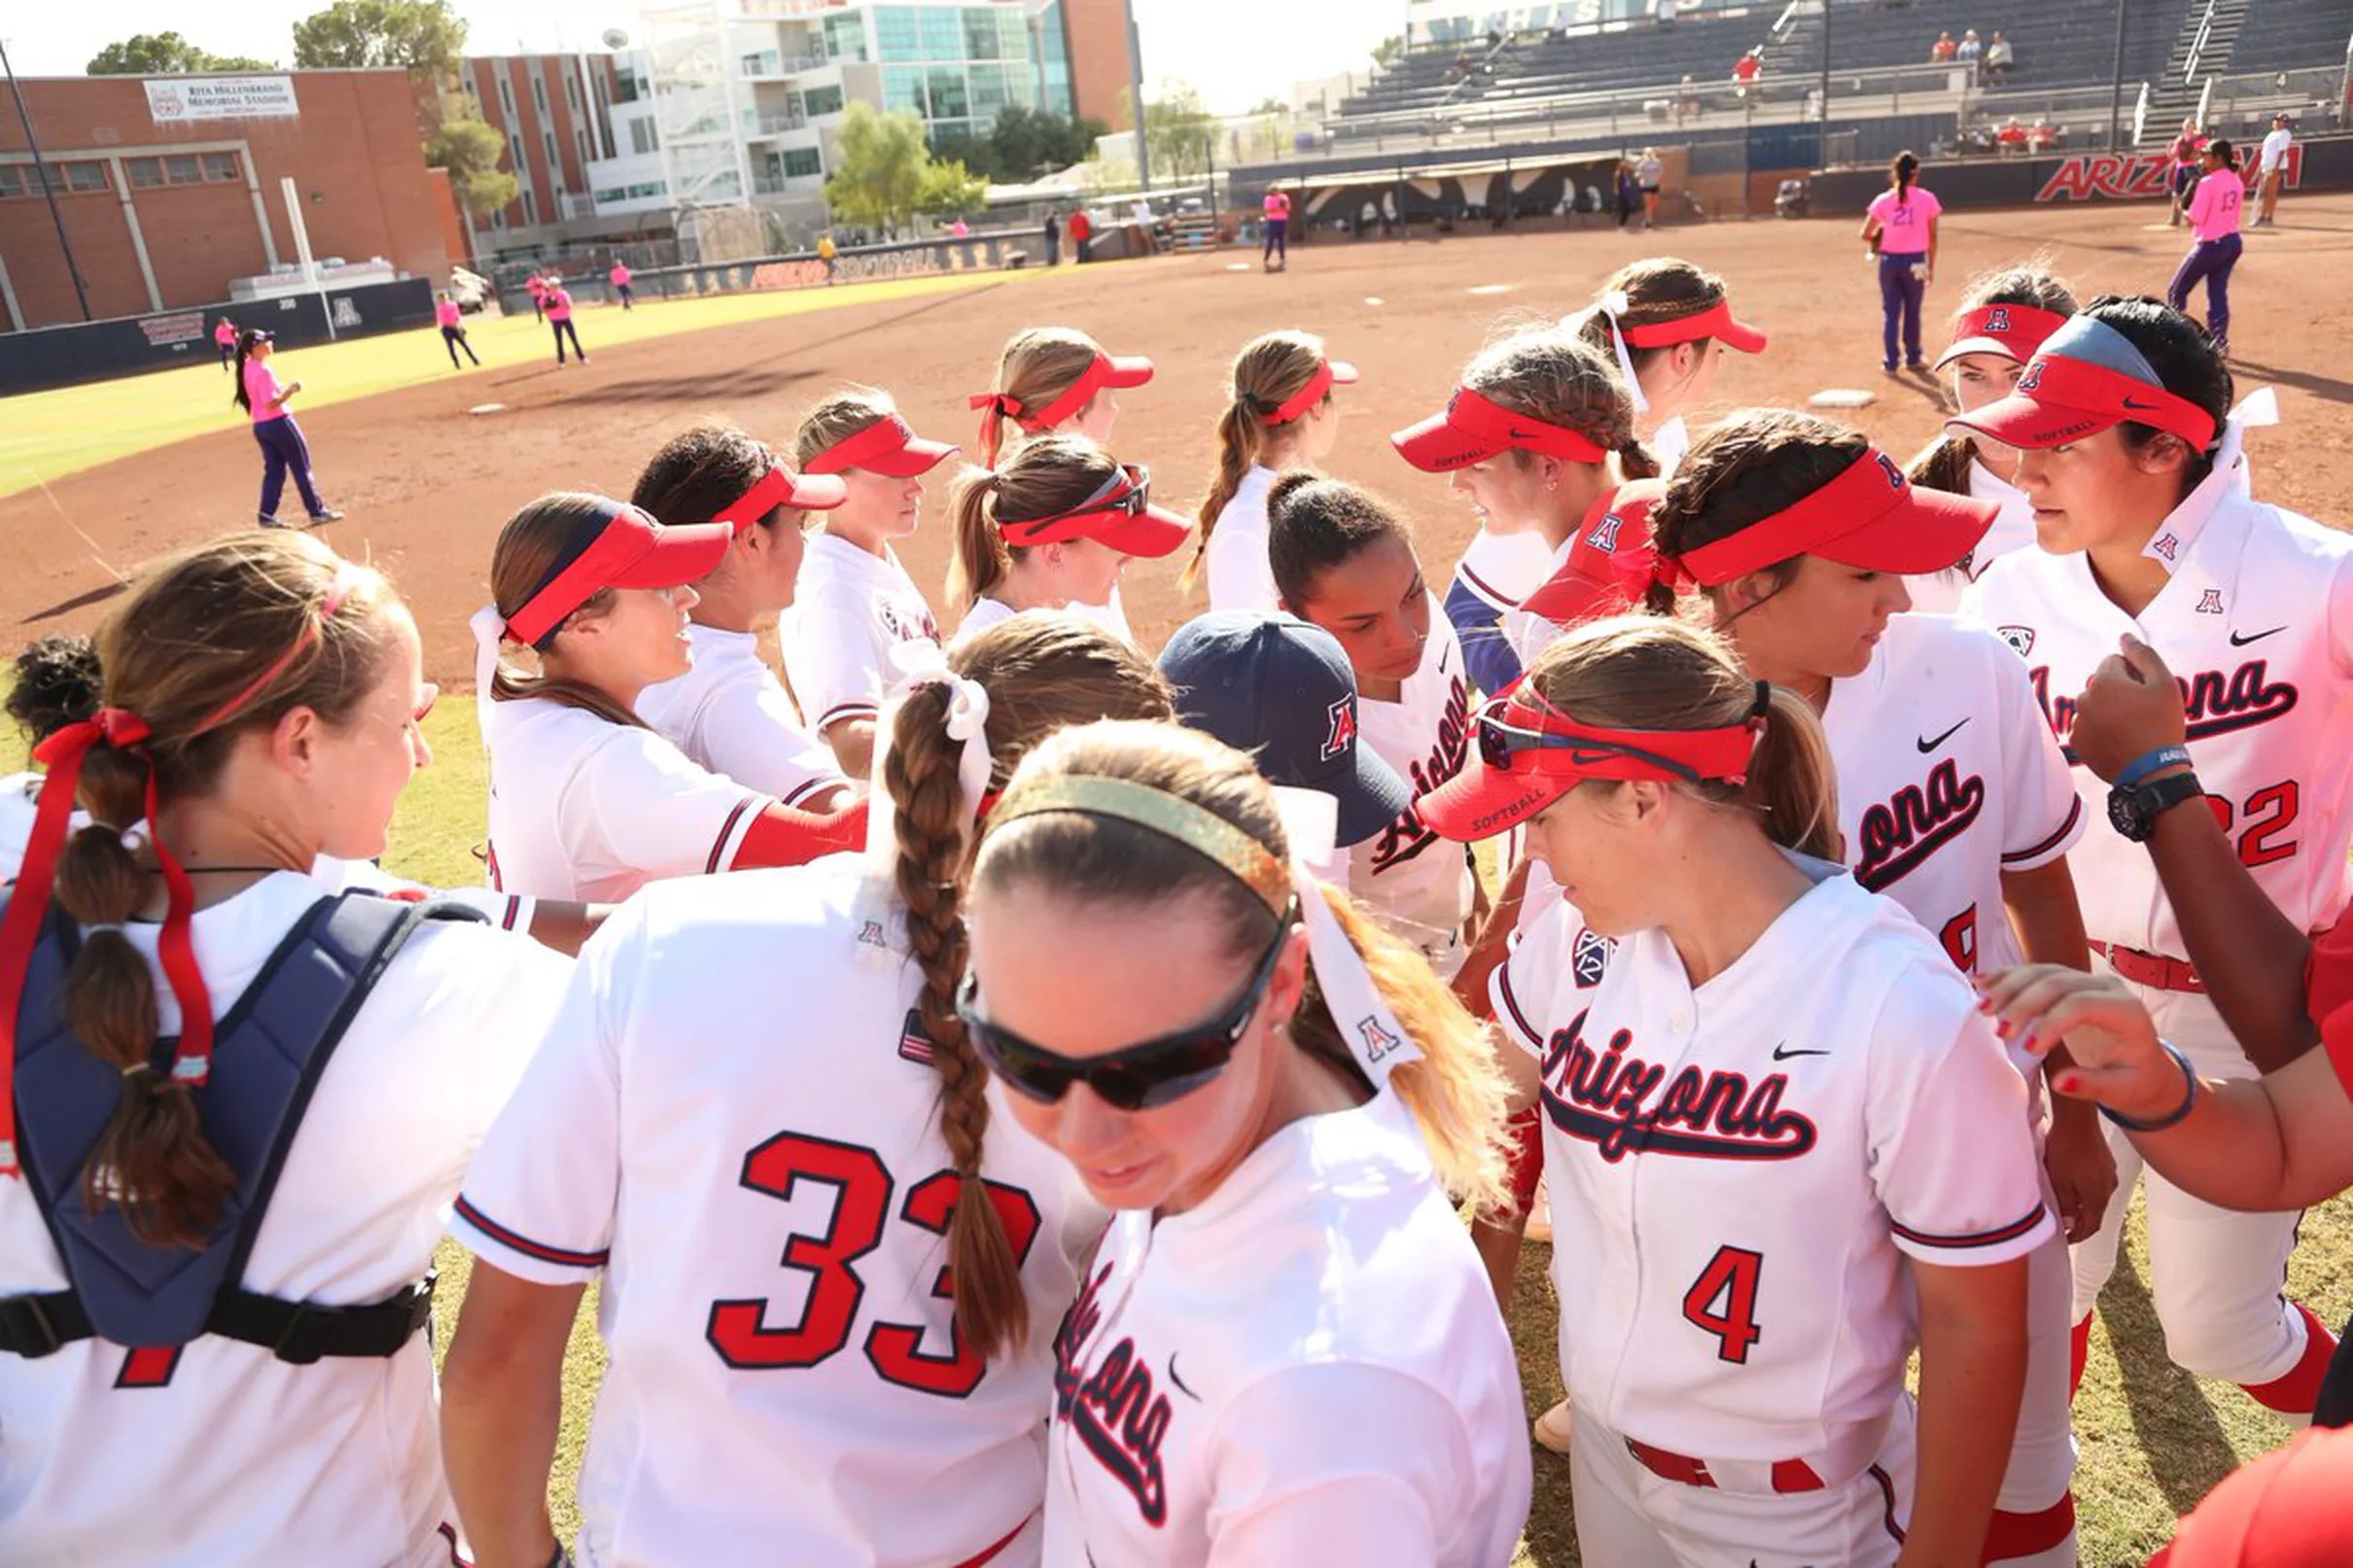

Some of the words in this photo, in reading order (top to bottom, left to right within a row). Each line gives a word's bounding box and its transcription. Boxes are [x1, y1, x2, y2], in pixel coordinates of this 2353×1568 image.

[188, 95, 242, 107] MEMORIAL
[2034, 142, 2303, 202] ARIZNA
[1892, 205, 1914, 226] 21
[2220, 190, 2238, 212] 13
[1984, 308, 2011, 332] A
[2033, 419, 2097, 443] SOFTBALL
[1434, 446, 1487, 468] SOFTBALL
[1585, 512, 1624, 554] A
[2152, 532, 2178, 562] A
[2195, 589, 2224, 614] A
[1320, 691, 1357, 762] A
[1471, 786, 1547, 833] SOFTBALL
[857, 919, 887, 949] A
[1356, 1014, 1402, 1064] A
[1540, 1007, 1819, 1164] Arizona
[705, 1130, 1042, 1400] 33
[1682, 1244, 1764, 1365] 4
